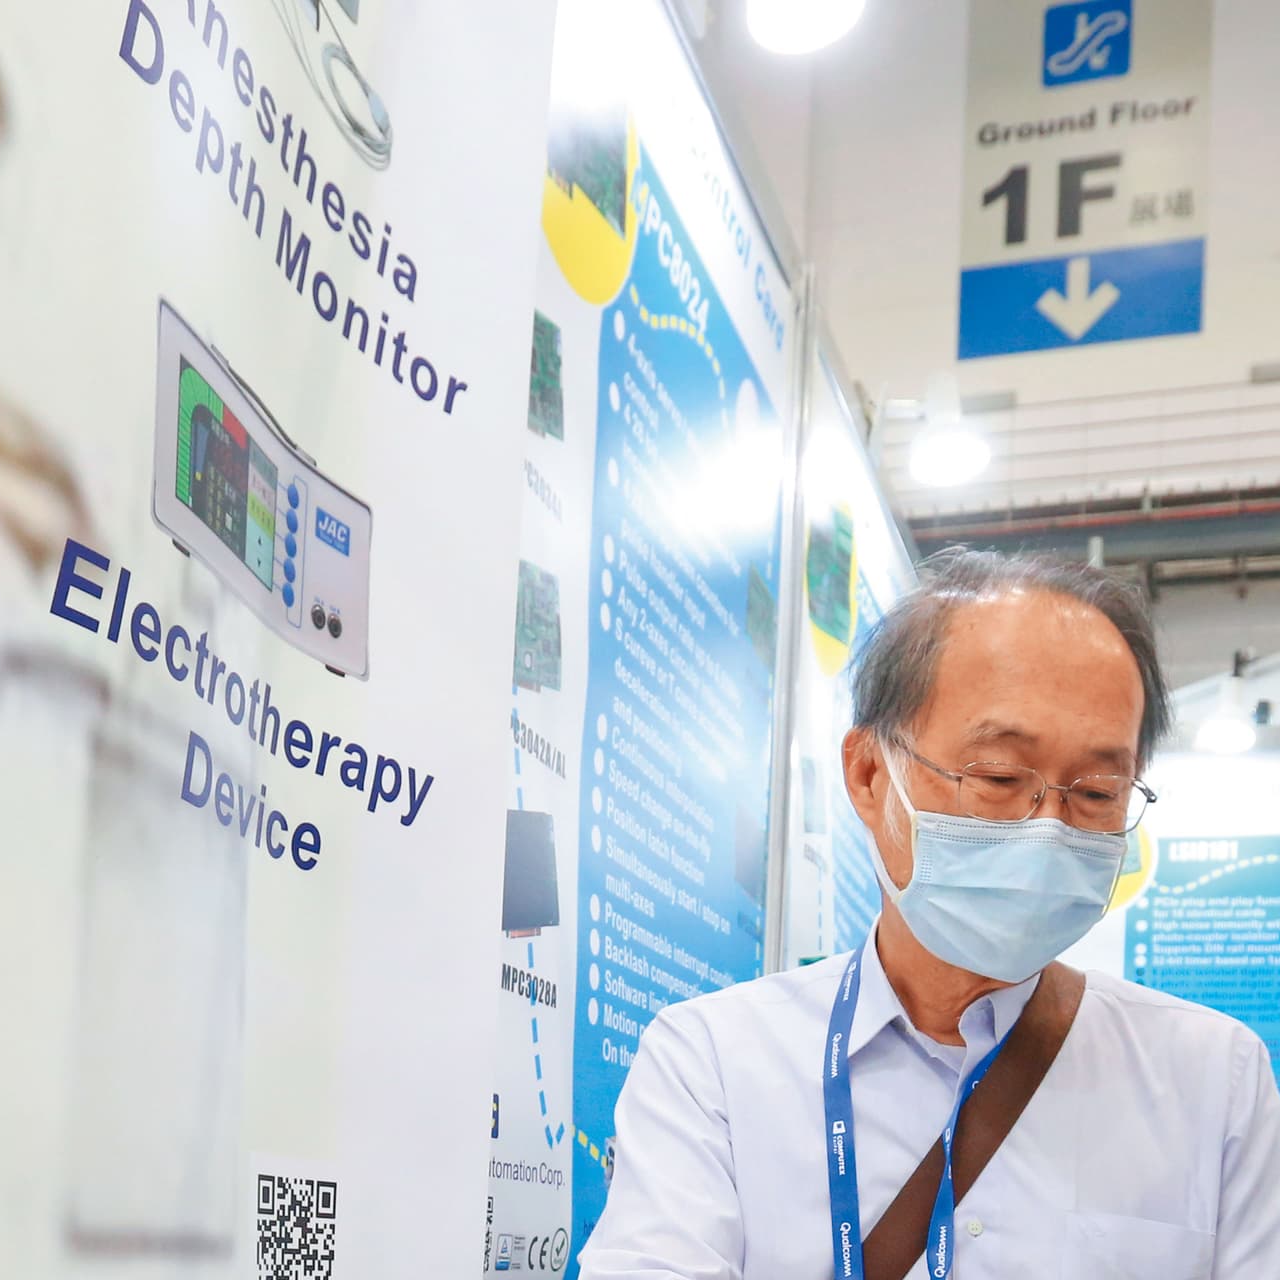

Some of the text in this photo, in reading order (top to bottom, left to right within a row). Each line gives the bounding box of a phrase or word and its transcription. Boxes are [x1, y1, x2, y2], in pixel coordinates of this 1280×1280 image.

[977, 97, 1197, 146] Ground Floor
[186, 0, 419, 301] nesthesia
[119, 0, 468, 415] Depth Monitor
[981, 152, 1123, 246] 1F
[318, 512, 349, 544] JAC
[49, 537, 434, 827] Electrotherapy
[180, 729, 321, 871] Device
[608, 759, 640, 801] Speed
[607, 796, 647, 845] Position
[606, 834, 677, 905] Simultaneously
[605, 873, 656, 919] multi-axes
[604, 935, 649, 978] Backlash
[605, 901, 709, 981] Programmable interrupt
[501, 963, 557, 1009] MPC3028A
[604, 969, 648, 1010] Software
[603, 1003, 638, 1038] Motion
[602, 1037, 618, 1064] On
[830, 1032, 843, 1079] Qualcomm
[539, 1162, 565, 1190] Corp.
[835, 1134, 847, 1176] COMPUTEX
[839, 1222, 854, 1278] Qualcomm
[933, 1225, 948, 1279] Qualcomm
